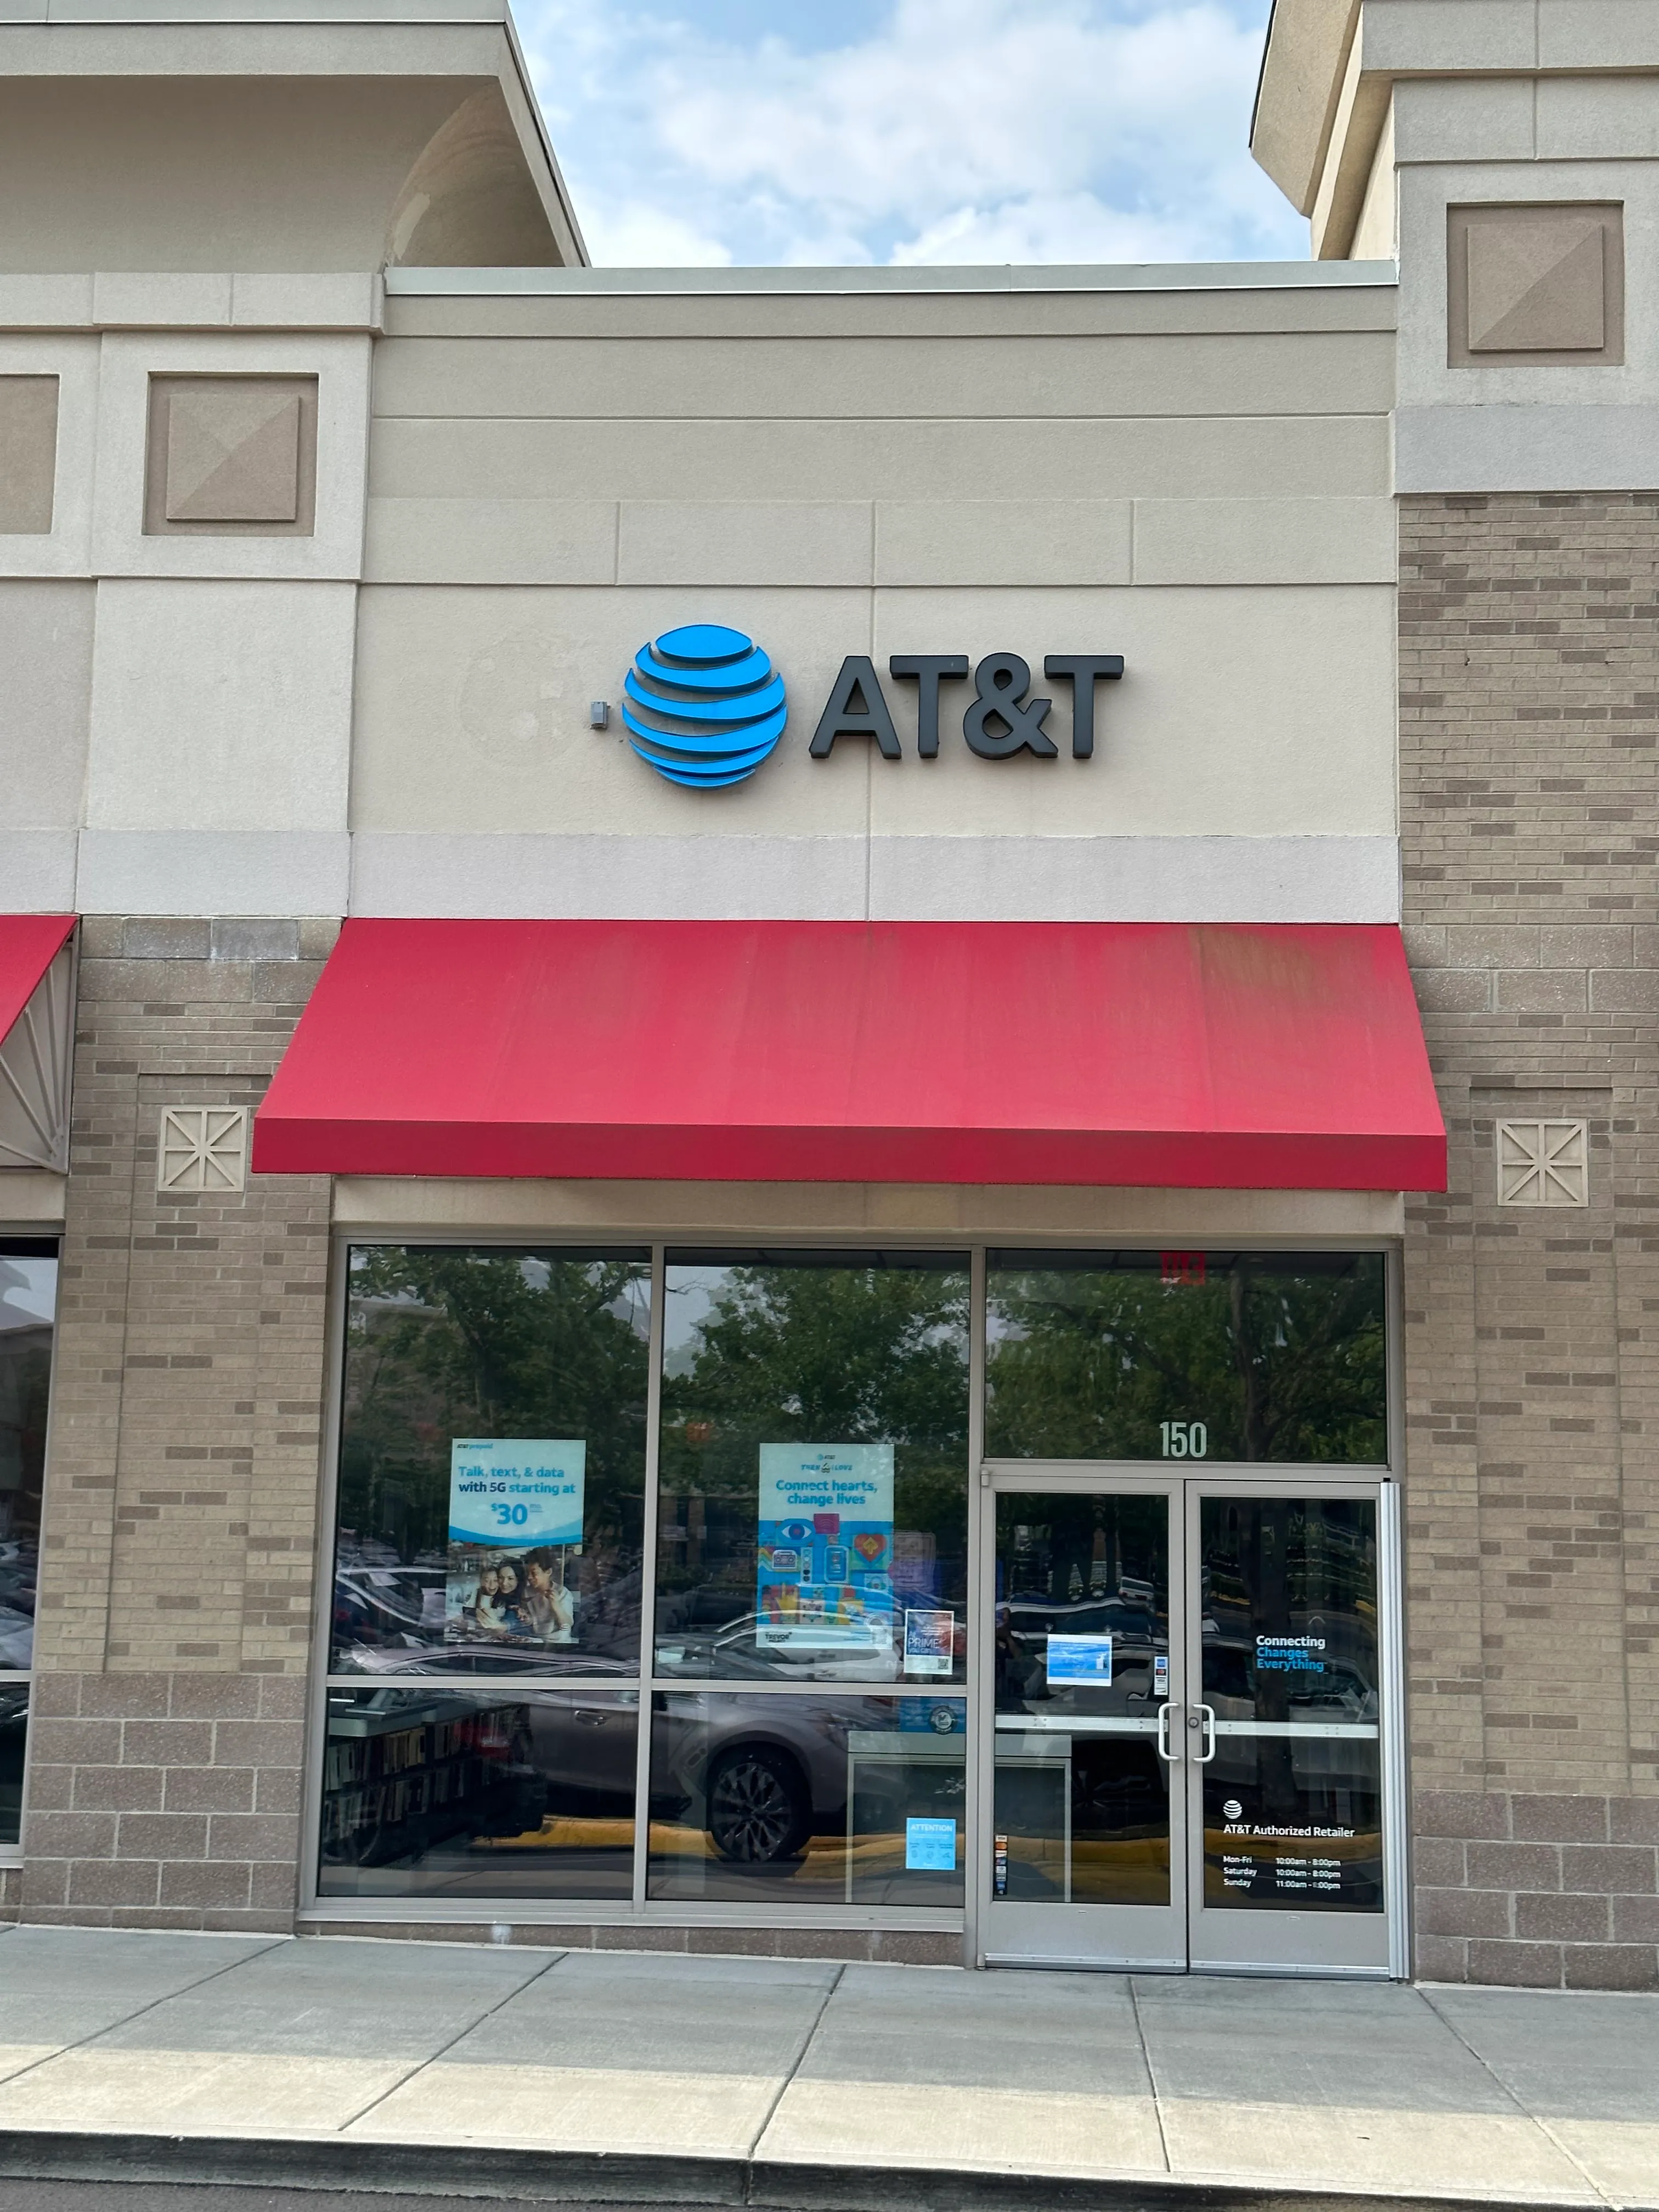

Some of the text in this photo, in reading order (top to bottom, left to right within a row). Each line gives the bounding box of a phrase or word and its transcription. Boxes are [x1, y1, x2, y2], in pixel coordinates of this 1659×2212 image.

[808, 652, 1125, 760] AT&T
[1159, 1421, 1207, 1458] 150
[458, 1466, 565, 1479] Talk, text, & data
[459, 1481, 576, 1496] with 5G starting at
[776, 1480, 878, 1493] Connect hearts,
[787, 1493, 866, 1507] change lives
[491, 1503, 528, 1525] $30
[908, 1637, 940, 1649] PRIME
[1256, 1635, 1326, 1650] Connecting
[1256, 1646, 1309, 1660] Changes
[1256, 1658, 1324, 1673] Everything
[910, 1824, 953, 1832] ATTENTION
[1223, 1824, 1355, 1837] AT&T Authorized Retailer
[1222, 1855, 1252, 1864] Mon-Fri
[1275, 1857, 1307, 1865] 10:00am
[1223, 1867, 1257, 1877] Saturday
[1276, 1869, 1307, 1877] 10:00am
[1223, 1878, 1252, 1888] Sunday
[1276, 1880, 1307, 1888] 11:00am
